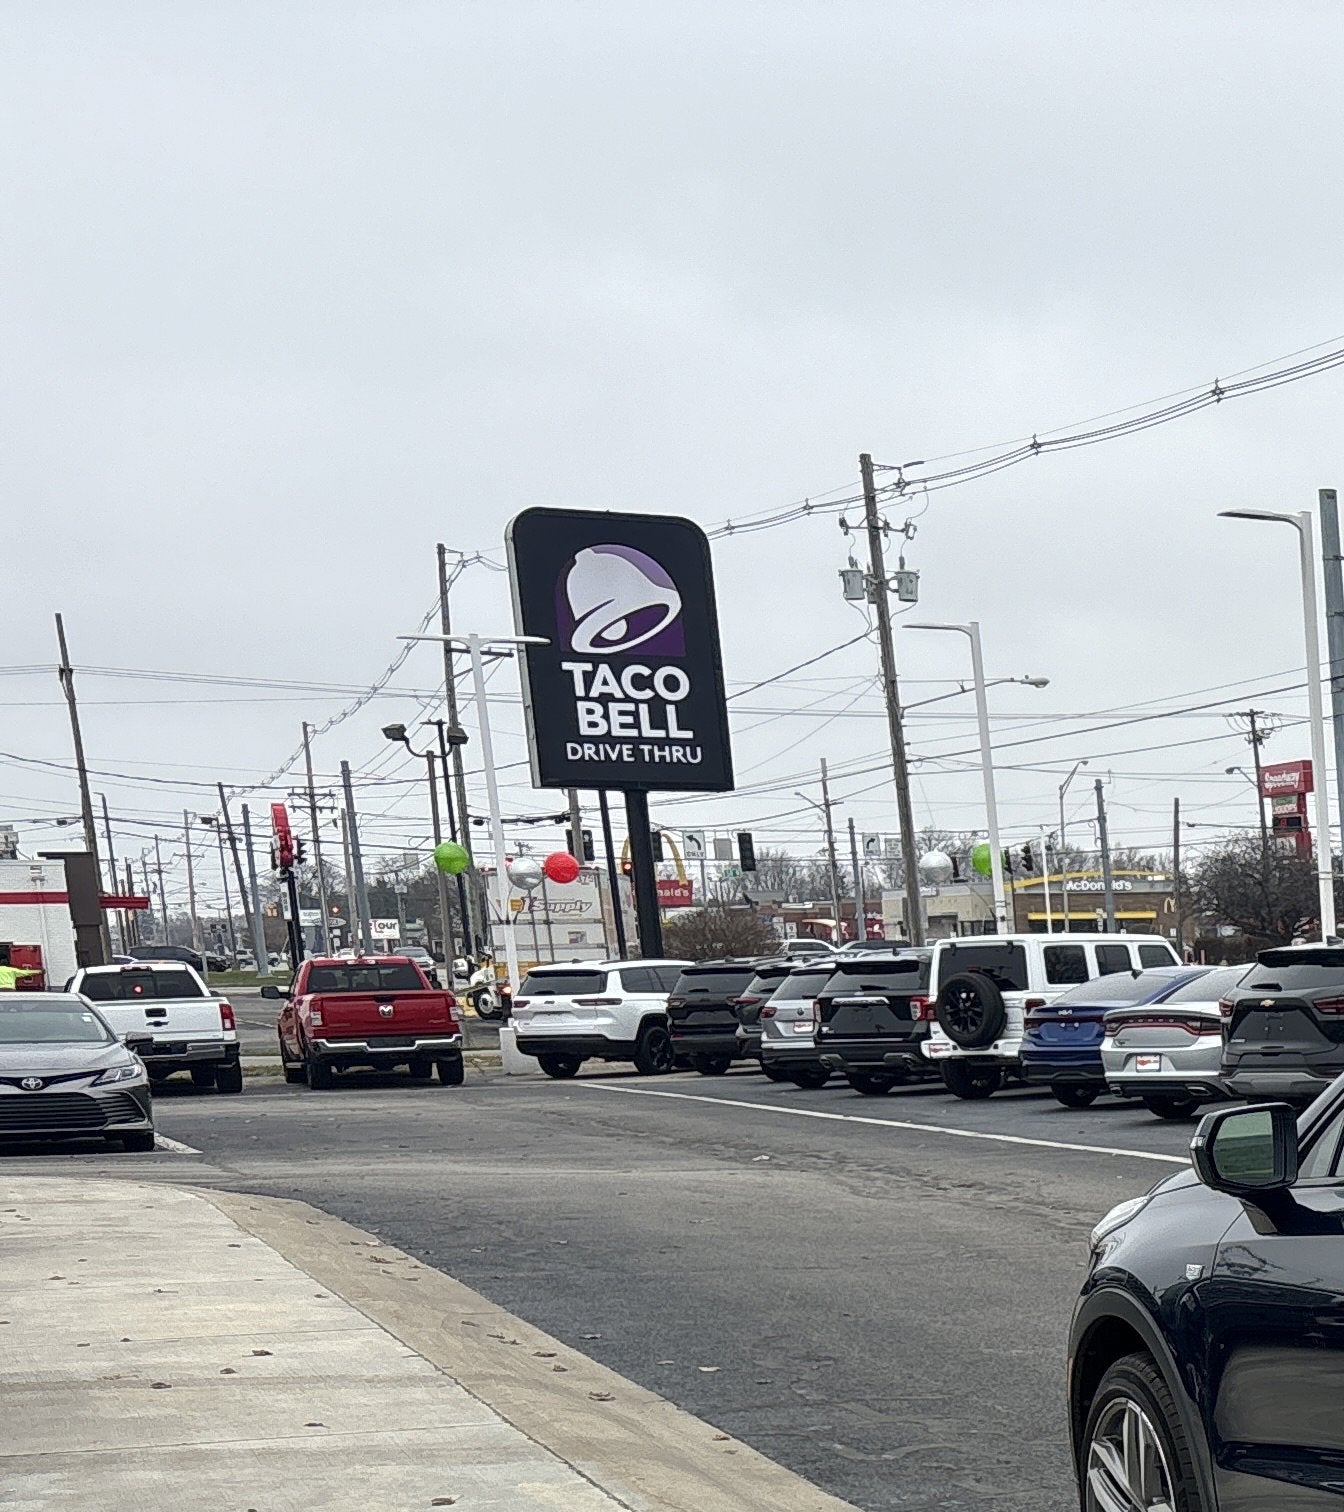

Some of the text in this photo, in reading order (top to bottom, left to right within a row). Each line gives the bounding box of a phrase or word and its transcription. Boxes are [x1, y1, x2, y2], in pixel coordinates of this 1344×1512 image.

[561, 661, 690, 701] TACO
[576, 700, 694, 739] BELL
[566, 742, 702, 764] DRIVE THRU
[1264, 770, 1300, 792] Speedway
[656, 887, 690, 897] nald's
